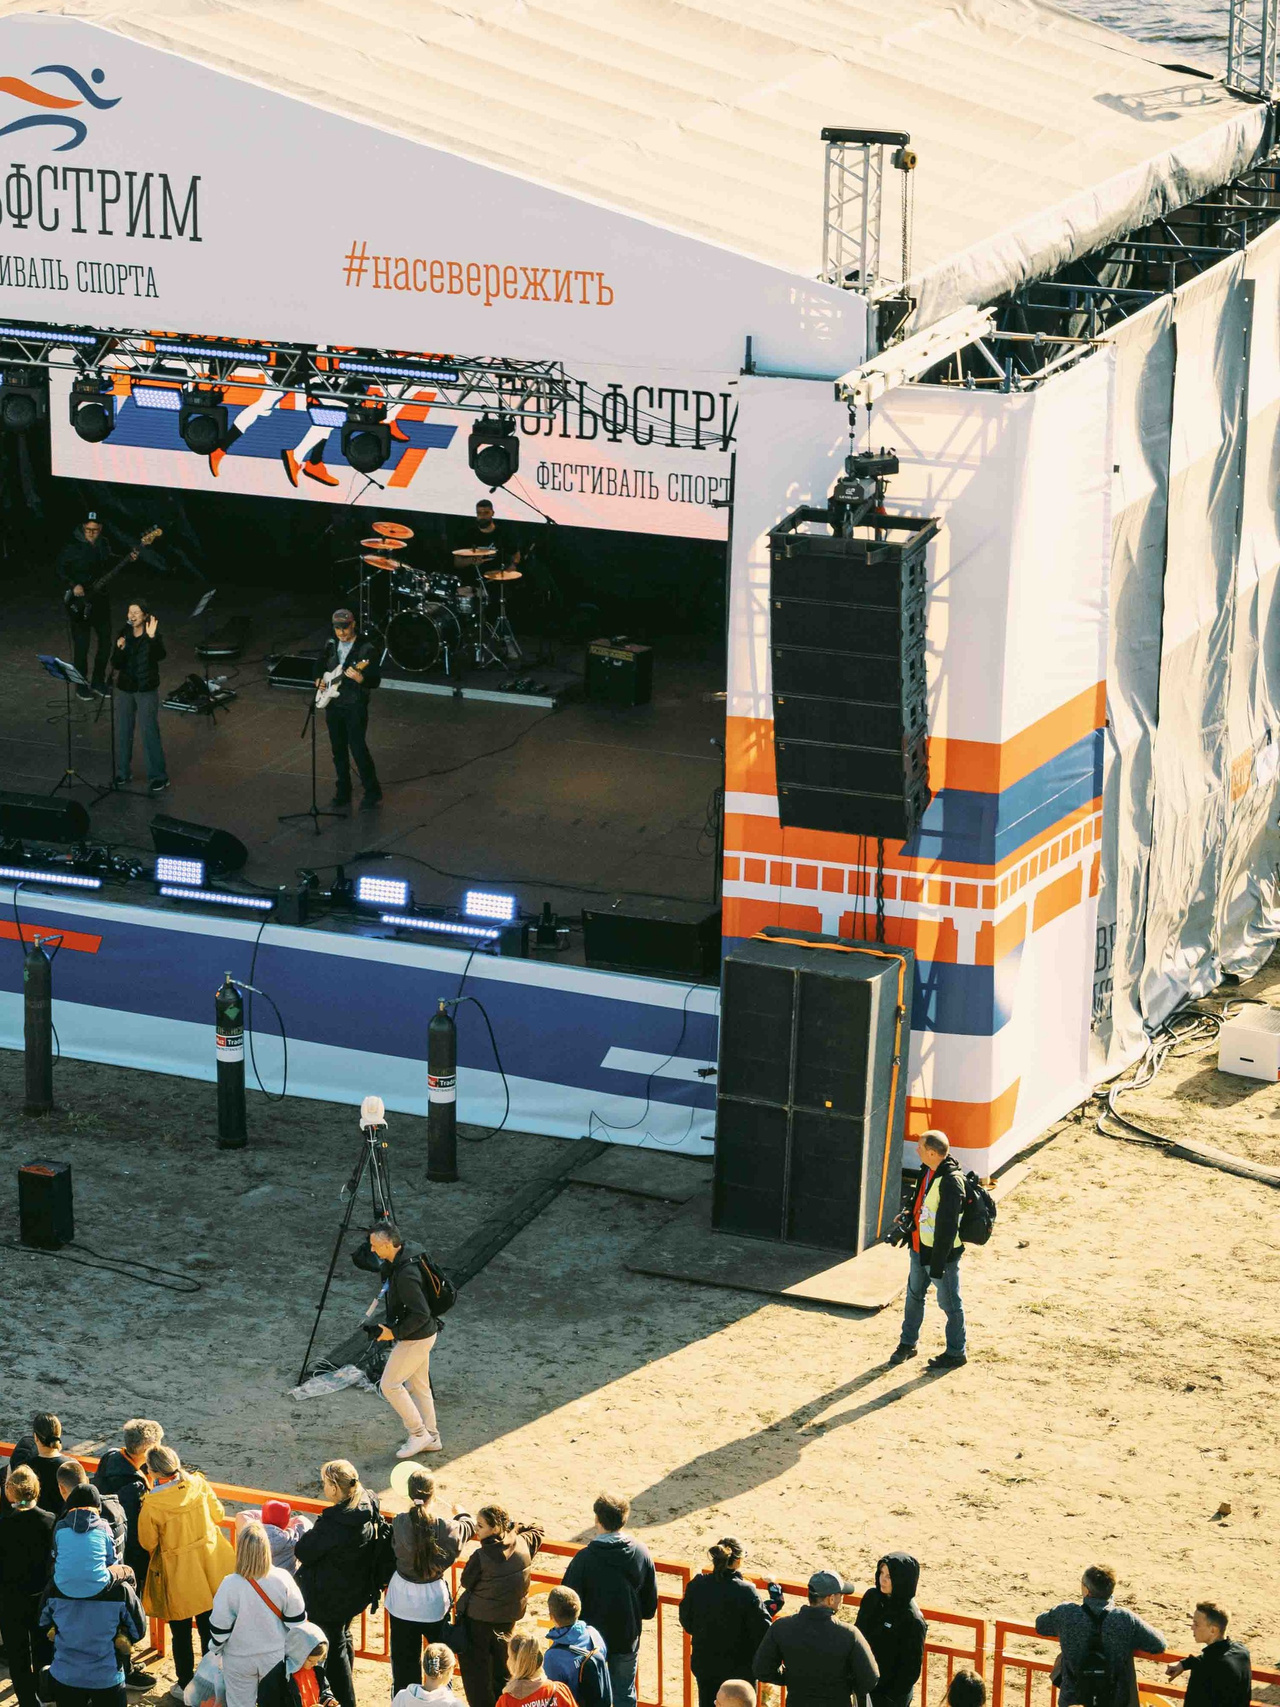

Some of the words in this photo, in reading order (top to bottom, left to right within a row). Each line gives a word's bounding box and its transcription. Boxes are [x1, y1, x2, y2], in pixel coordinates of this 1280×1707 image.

[76, 260, 160, 299] СПОРТА
[342, 240, 615, 306] #насевережить
[536, 461, 659, 500] ФЕСТИВАЛЬ
